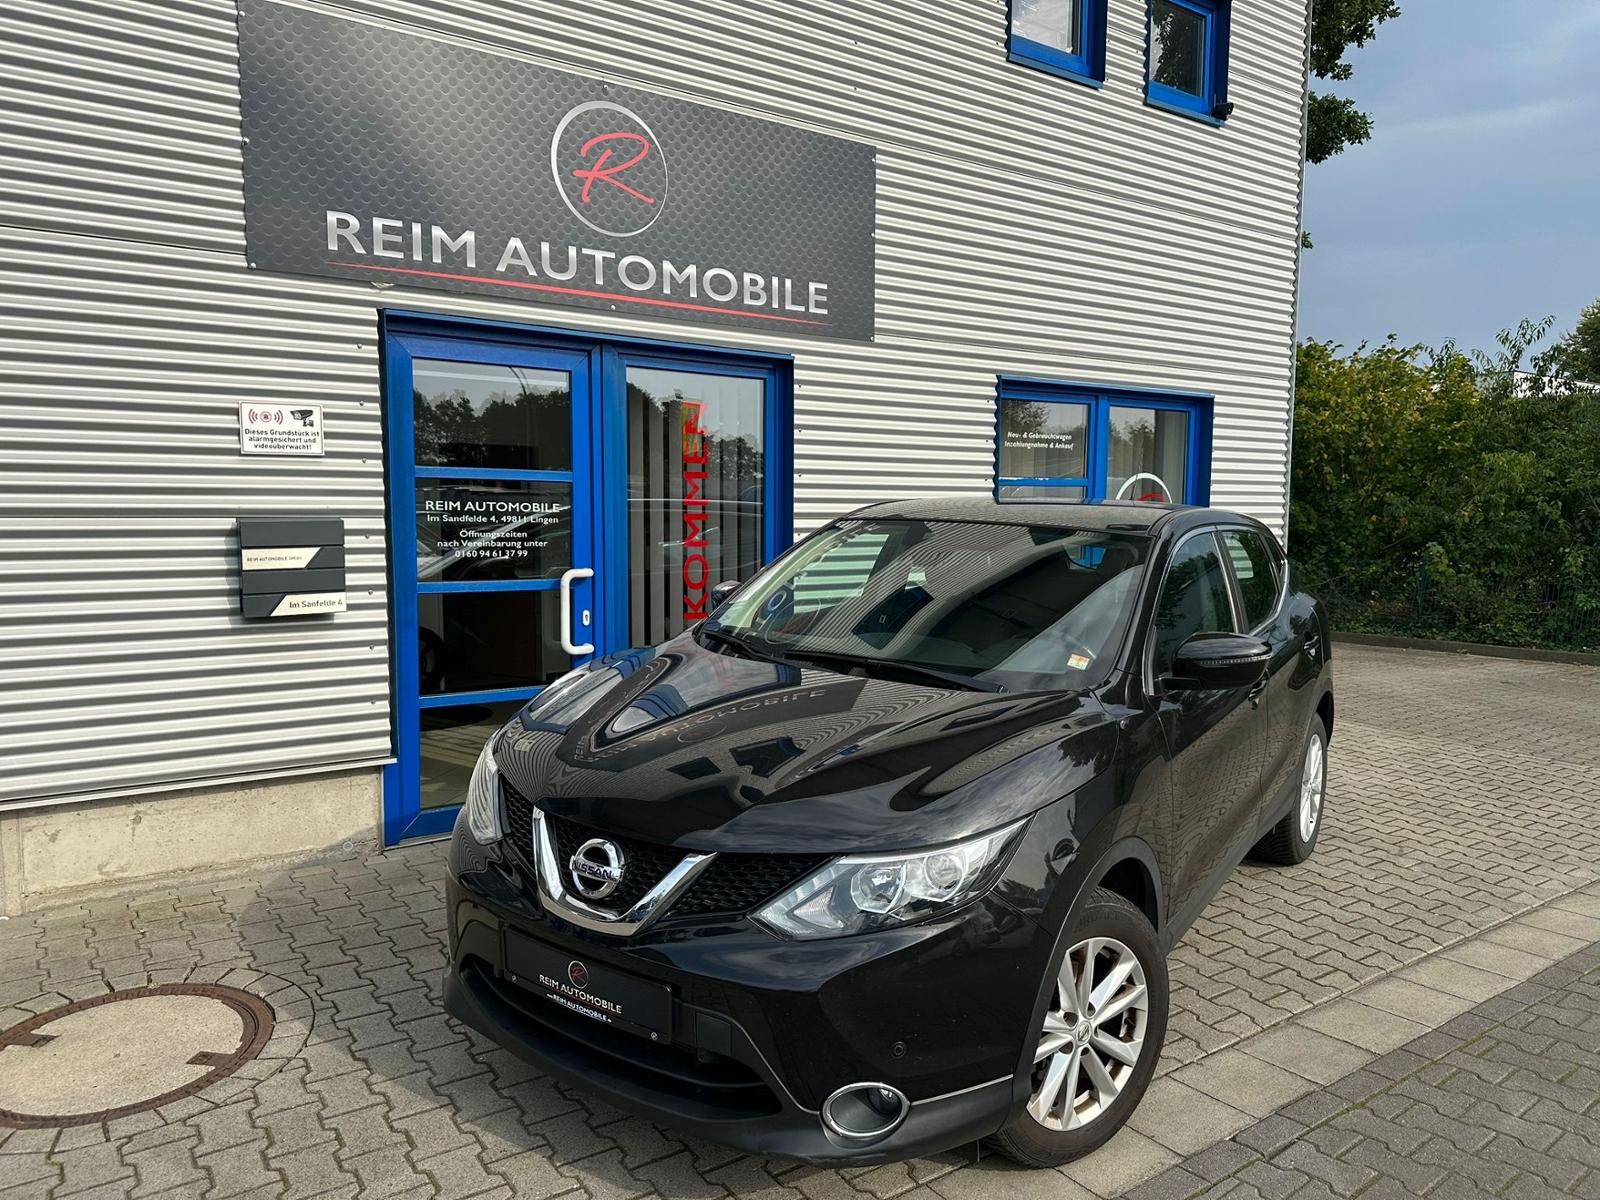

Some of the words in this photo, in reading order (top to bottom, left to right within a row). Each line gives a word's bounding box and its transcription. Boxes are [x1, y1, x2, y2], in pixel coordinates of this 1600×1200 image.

[572, 131, 655, 204] R
[326, 210, 476, 268] REIM
[495, 236, 829, 315] AUTOMOBILE
[269, 428, 310, 437] Grundstück
[1022, 431, 1028, 439] &
[1028, 432, 1072, 441] Gebrauchtwagen
[1004, 440, 1049, 449] Inzahlungnahme
[1055, 442, 1074, 451] Ankauf
[425, 500, 461, 511] REIM
[464, 501, 561, 513] AUTOMOBILE
[427, 514, 440, 522] Im
[442, 514, 488, 523] Sandfelde
[489, 515, 499, 523] 4,
[530, 517, 559, 525] Lingen
[459, 528, 528, 539] Öffnungszeiten
[460, 540, 522, 548] Vereinbarung
[454, 550, 478, 558] 0160
[301, 600, 336, 608] Sanfelde
[539, 974, 559, 989] REIM
[560, 983, 622, 1014] AUTOMOBILE
